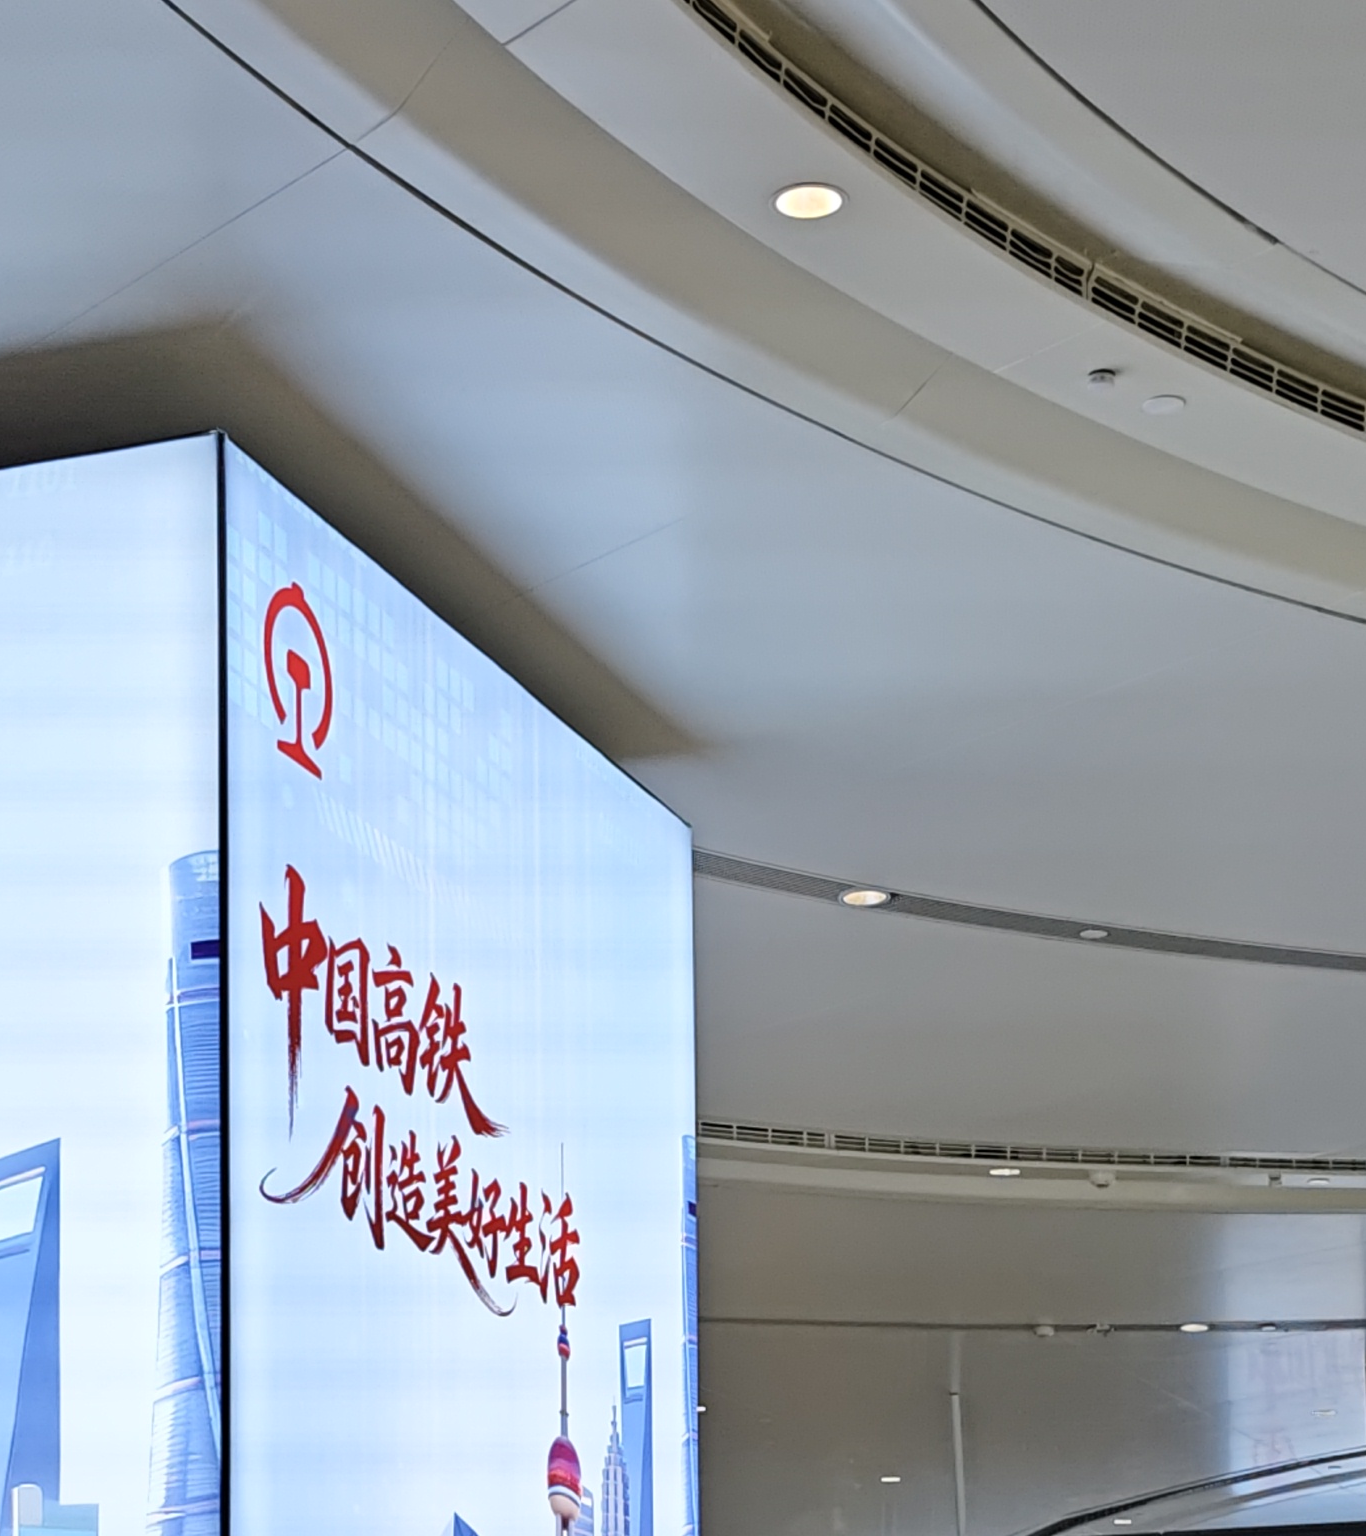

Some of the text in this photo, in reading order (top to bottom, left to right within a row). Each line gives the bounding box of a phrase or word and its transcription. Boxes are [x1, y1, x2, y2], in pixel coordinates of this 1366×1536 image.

[260, 864, 510, 1142] 中国高铁
[259, 1085, 580, 1316] 创造美好生活
